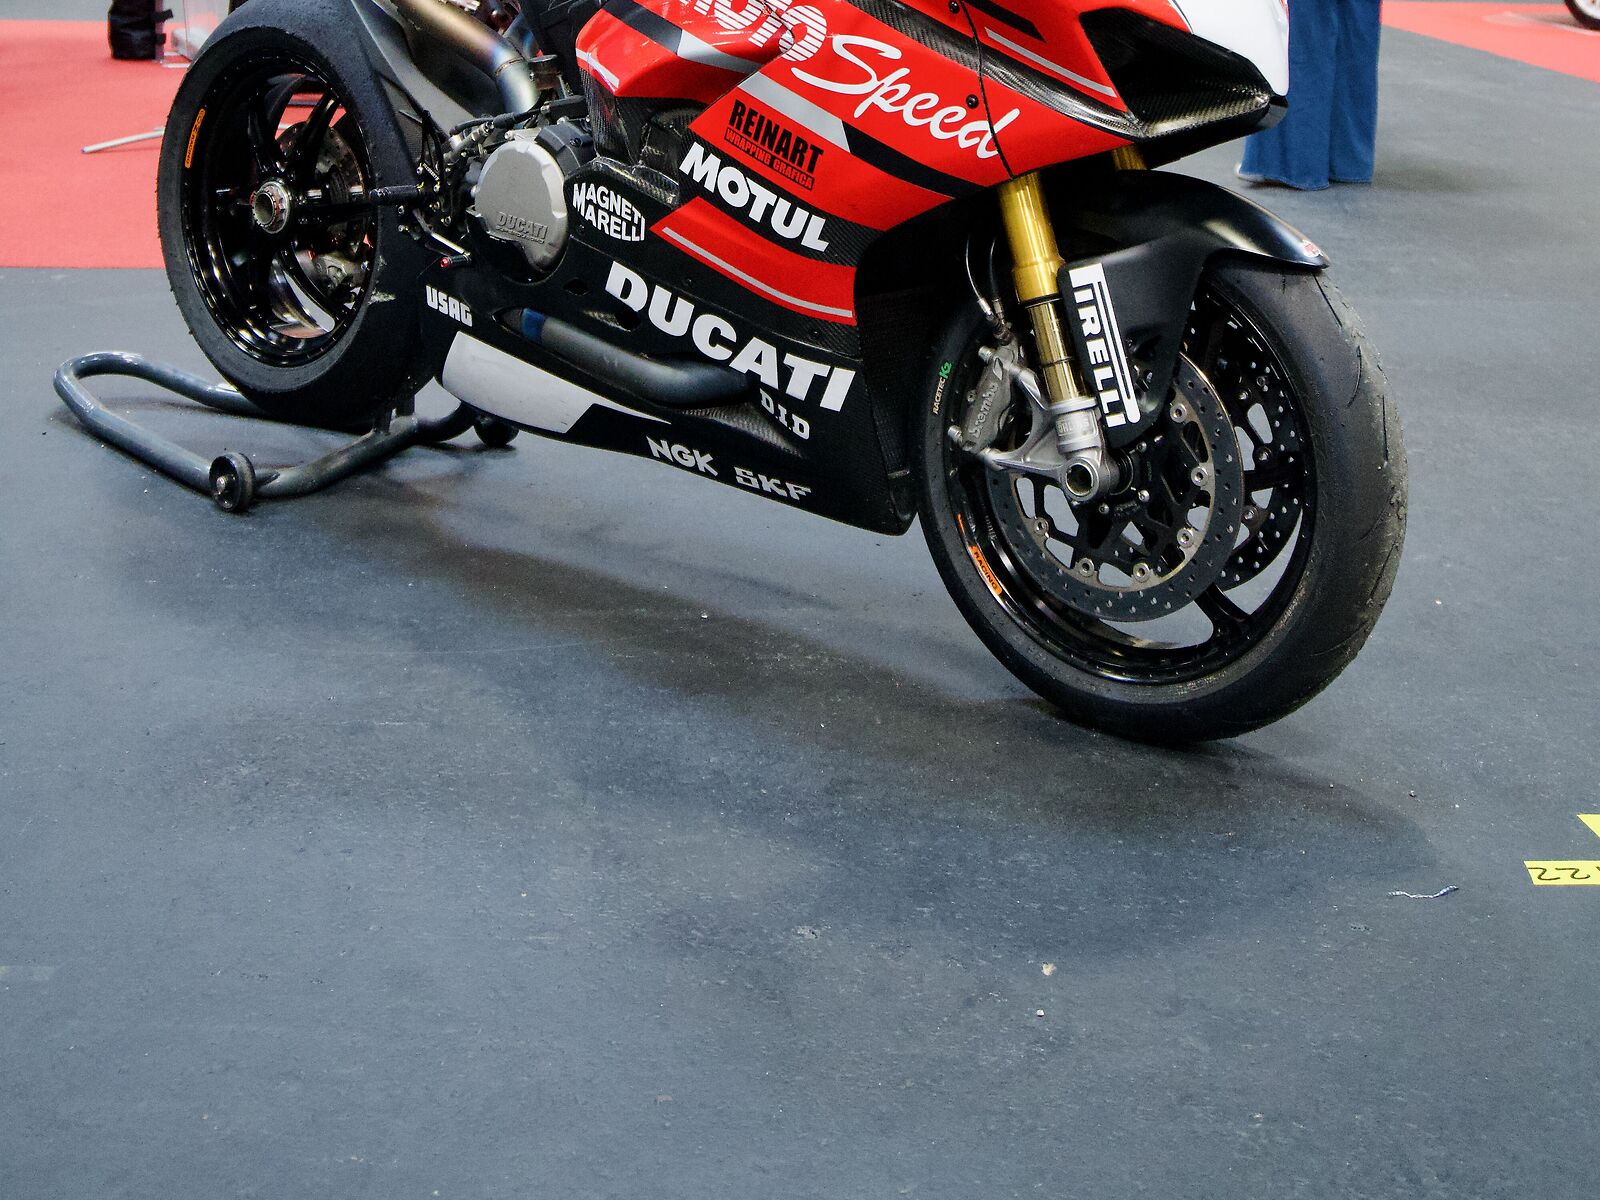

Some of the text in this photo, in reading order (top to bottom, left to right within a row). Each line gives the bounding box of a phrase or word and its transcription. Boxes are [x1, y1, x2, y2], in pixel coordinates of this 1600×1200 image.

[791, 34, 1020, 159] Speed
[725, 128, 813, 189] WRAPPING GRAFICA
[729, 99, 824, 174] REINART
[573, 182, 645, 226] MAGNETI
[573, 205, 645, 241] MARELLI
[679, 141, 829, 252] MOTUL
[497, 212, 548, 240] DUCATI
[425, 285, 472, 327] USAG
[605, 261, 856, 412] DUCATI
[1069, 263, 1140, 427] PIRELLI
[759, 389, 810, 440] D.I.D
[932, 361, 953, 415] RACETEC K2
[646, 435, 811, 500] NGK SKF
[974, 551, 997, 589] RACING
